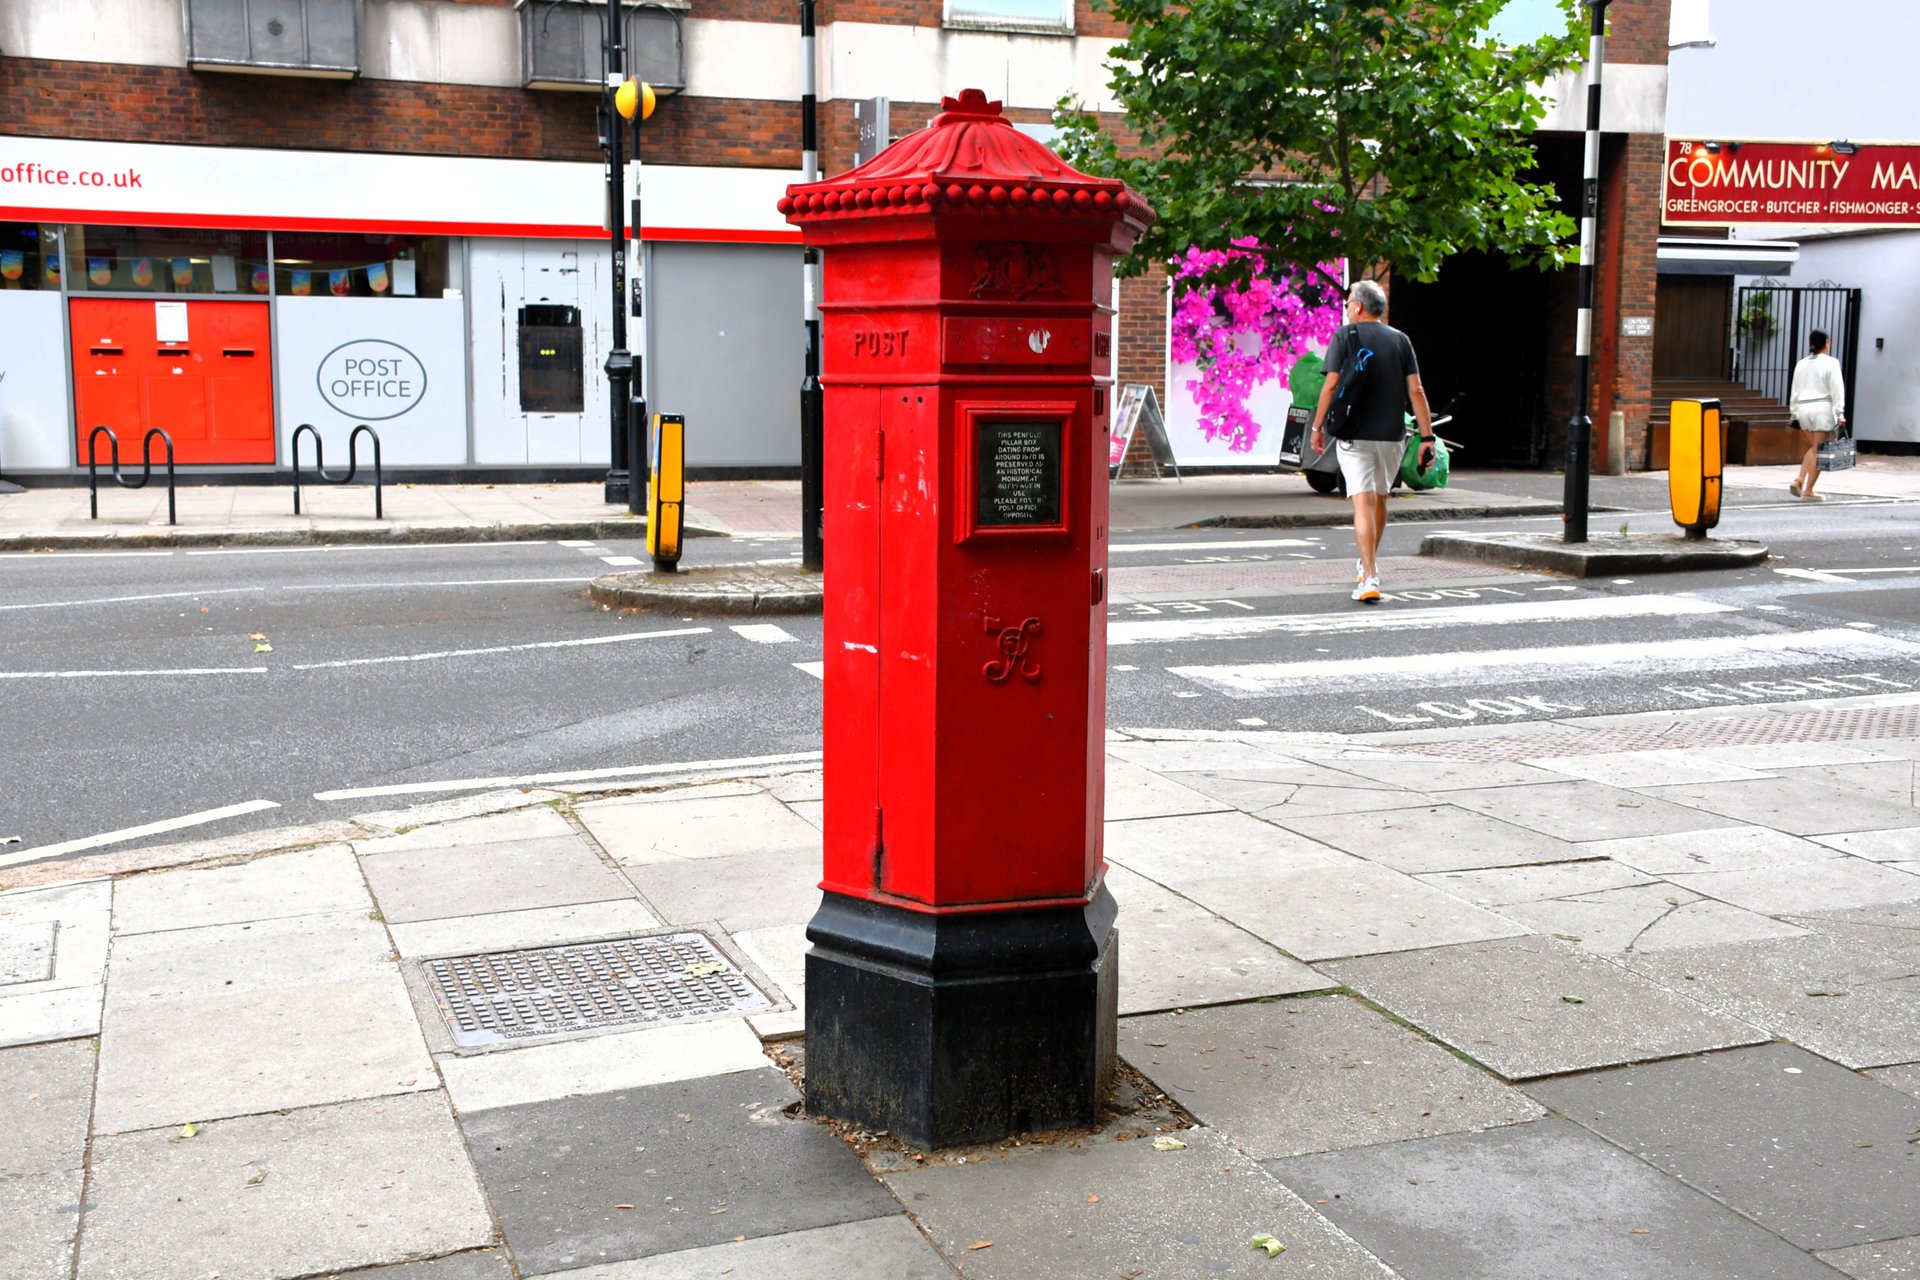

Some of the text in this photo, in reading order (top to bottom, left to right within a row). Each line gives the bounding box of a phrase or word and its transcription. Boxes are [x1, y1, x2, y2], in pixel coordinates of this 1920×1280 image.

[1679, 141, 1692, 155] 78
[1, 162, 142, 188] office.co.uk
[1669, 157, 1920, 190] COMMUNITY MA
[1667, 198, 1758, 214] GREENGROCER
[1766, 200, 1820, 214] BUTCHER
[1829, 201, 1908, 215] FISHMONGER
[854, 330, 909, 357] POST
[345, 358, 403, 376] POST
[331, 379, 411, 397] OFFICE
[1354, 673, 1912, 723] LOOK RIGHT
